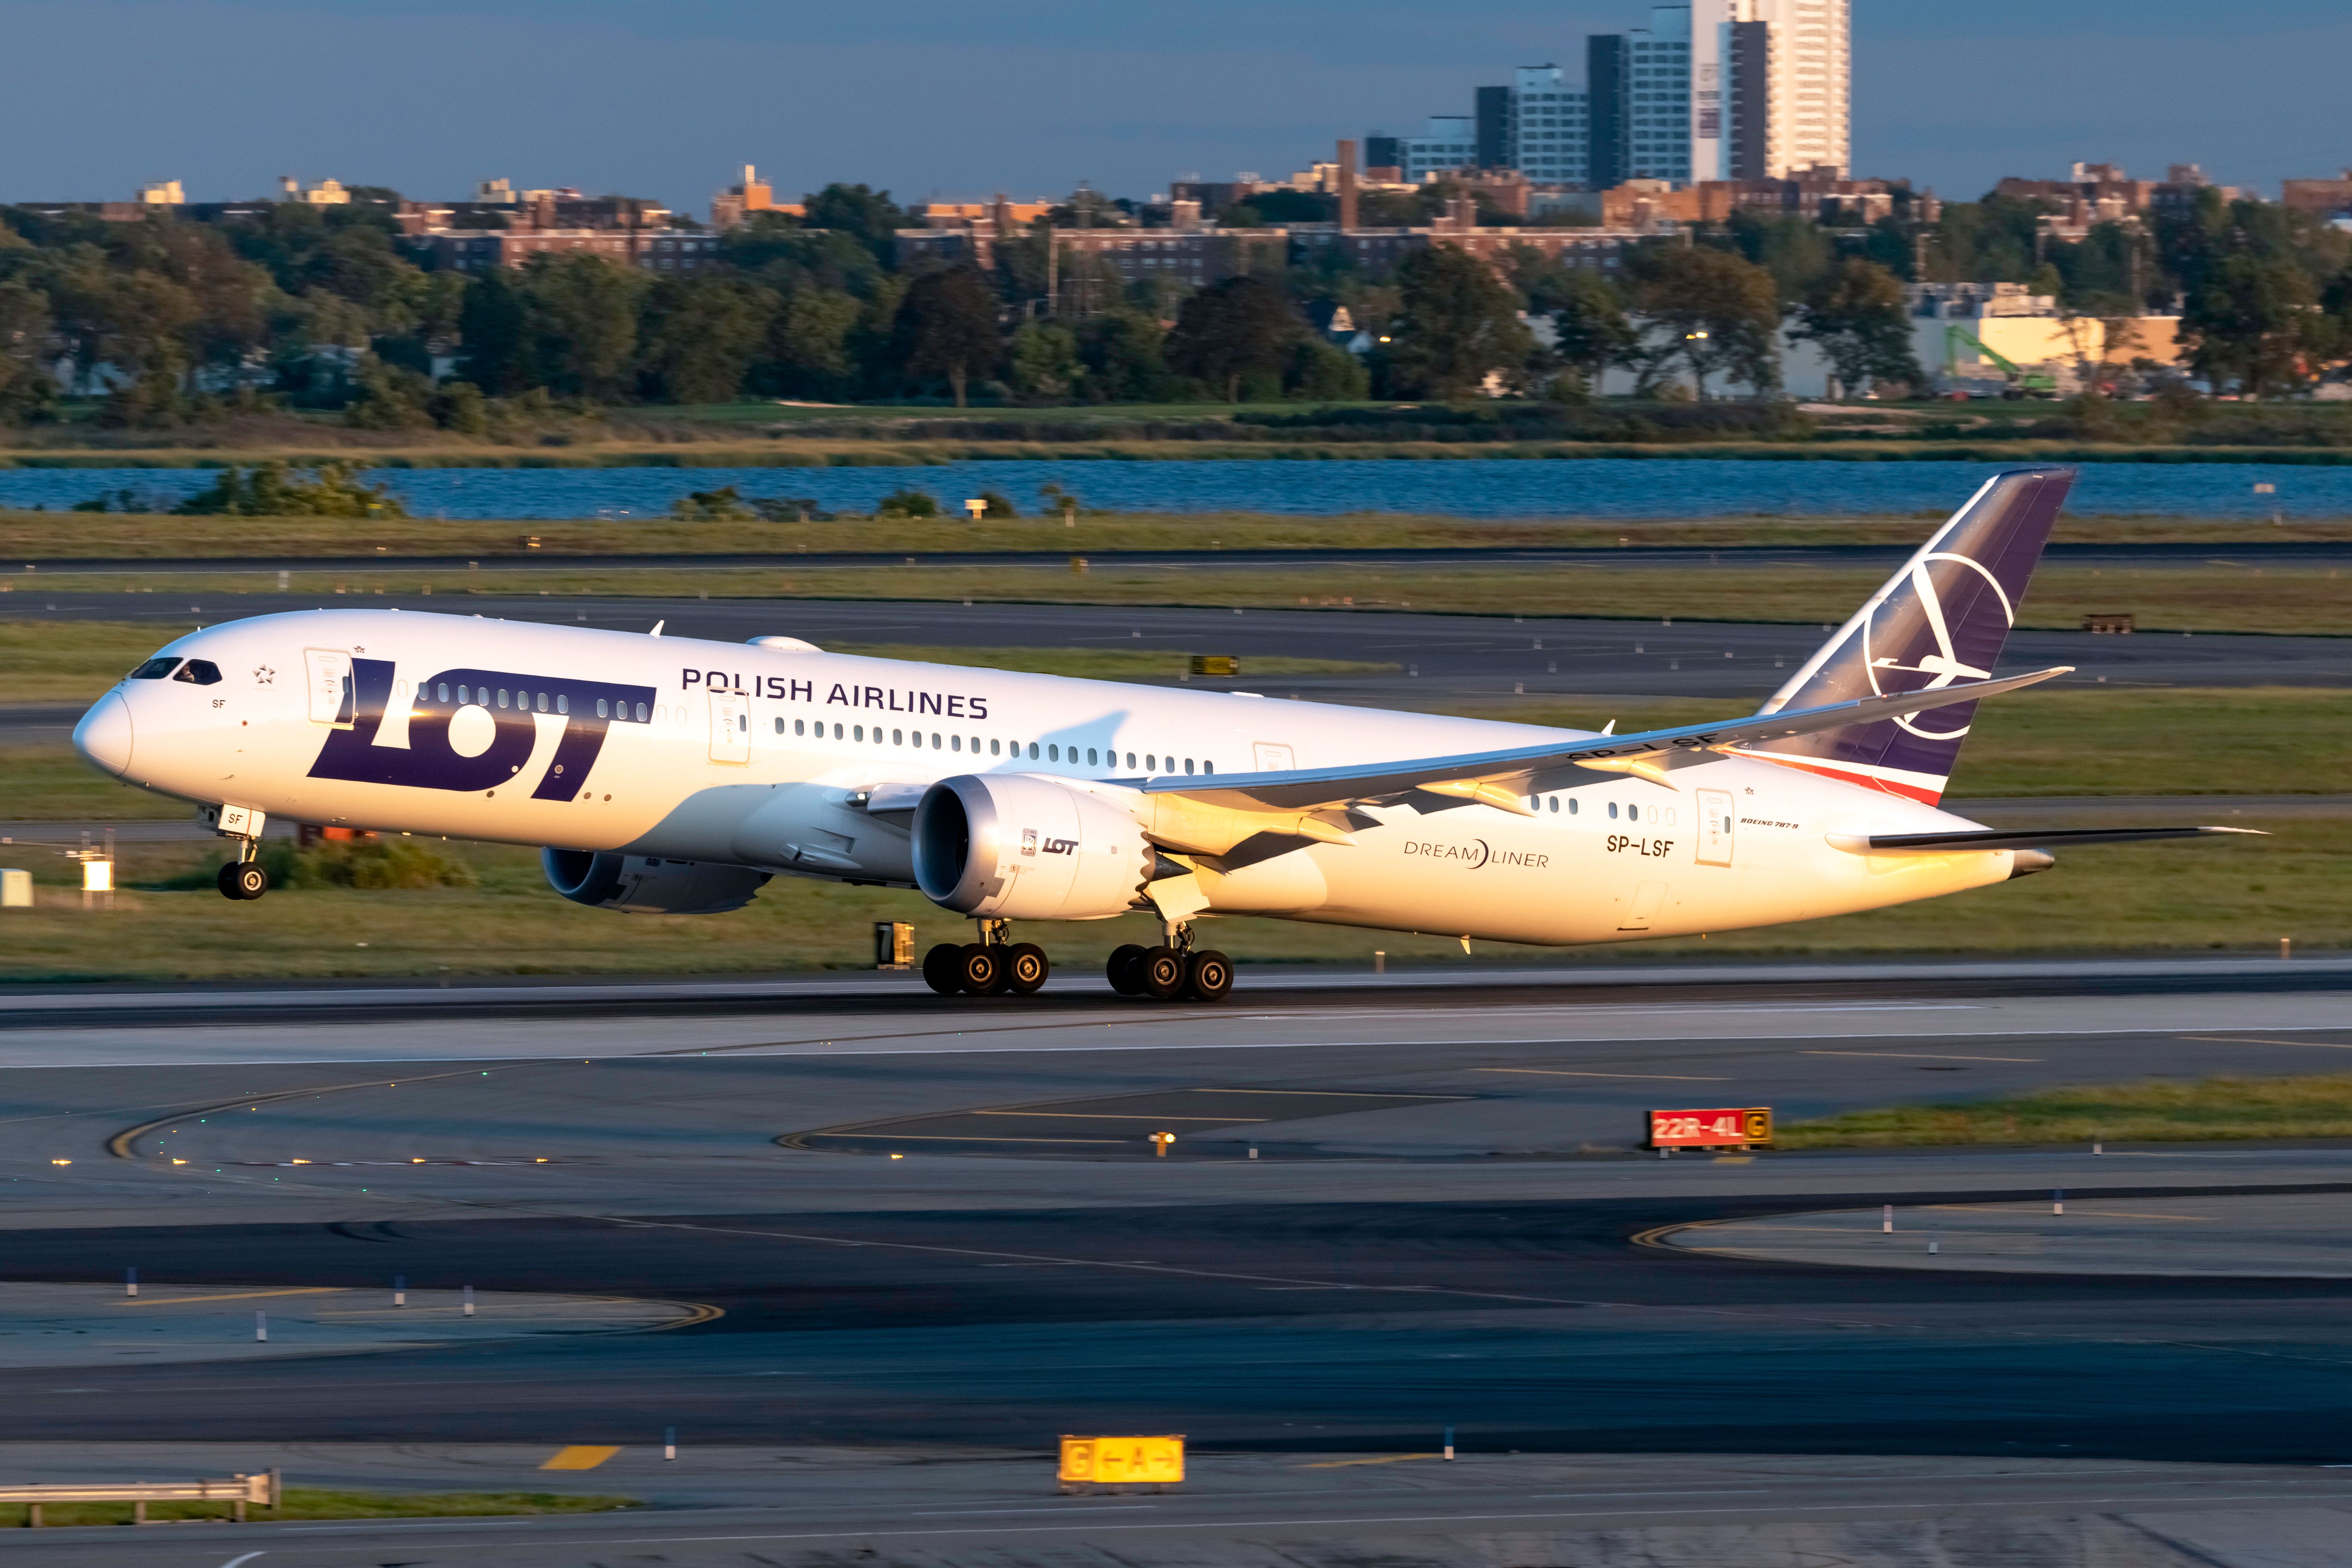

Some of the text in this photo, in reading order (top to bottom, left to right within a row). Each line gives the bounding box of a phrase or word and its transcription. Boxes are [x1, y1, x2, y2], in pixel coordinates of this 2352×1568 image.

[212, 699, 226, 708] SF
[682, 668, 987, 719] POLISH AIRLINES
[306, 658, 657, 802] LOT
[229, 813, 243, 824] SF
[1740, 818, 1773, 826] BOEING
[1042, 838, 1079, 856] LOT
[1607, 835, 1674, 858] SP-LSF
[1652, 1116, 1744, 1139] 22R-4L
[1126, 1446, 1149, 1473] A
